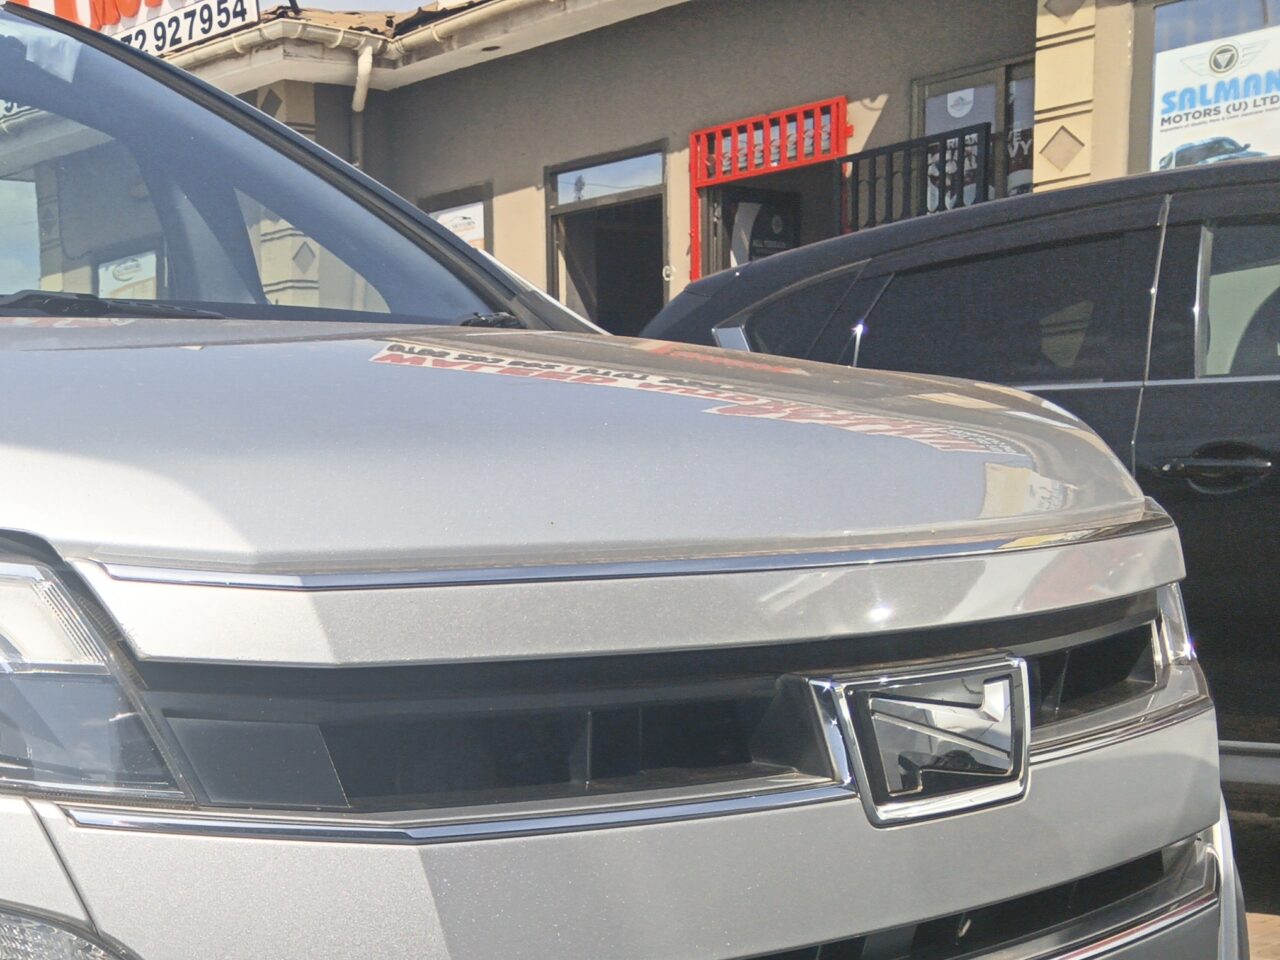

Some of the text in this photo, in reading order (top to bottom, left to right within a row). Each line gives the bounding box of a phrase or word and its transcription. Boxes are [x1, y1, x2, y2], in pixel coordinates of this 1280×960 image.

[153, 0, 248, 51] 927954
[1160, 106, 1221, 126] MOTORS
[1226, 100, 1248, 114] (U)
[1253, 94, 1280, 108] LTD
[1161, 68, 1280, 115] SALMAN
